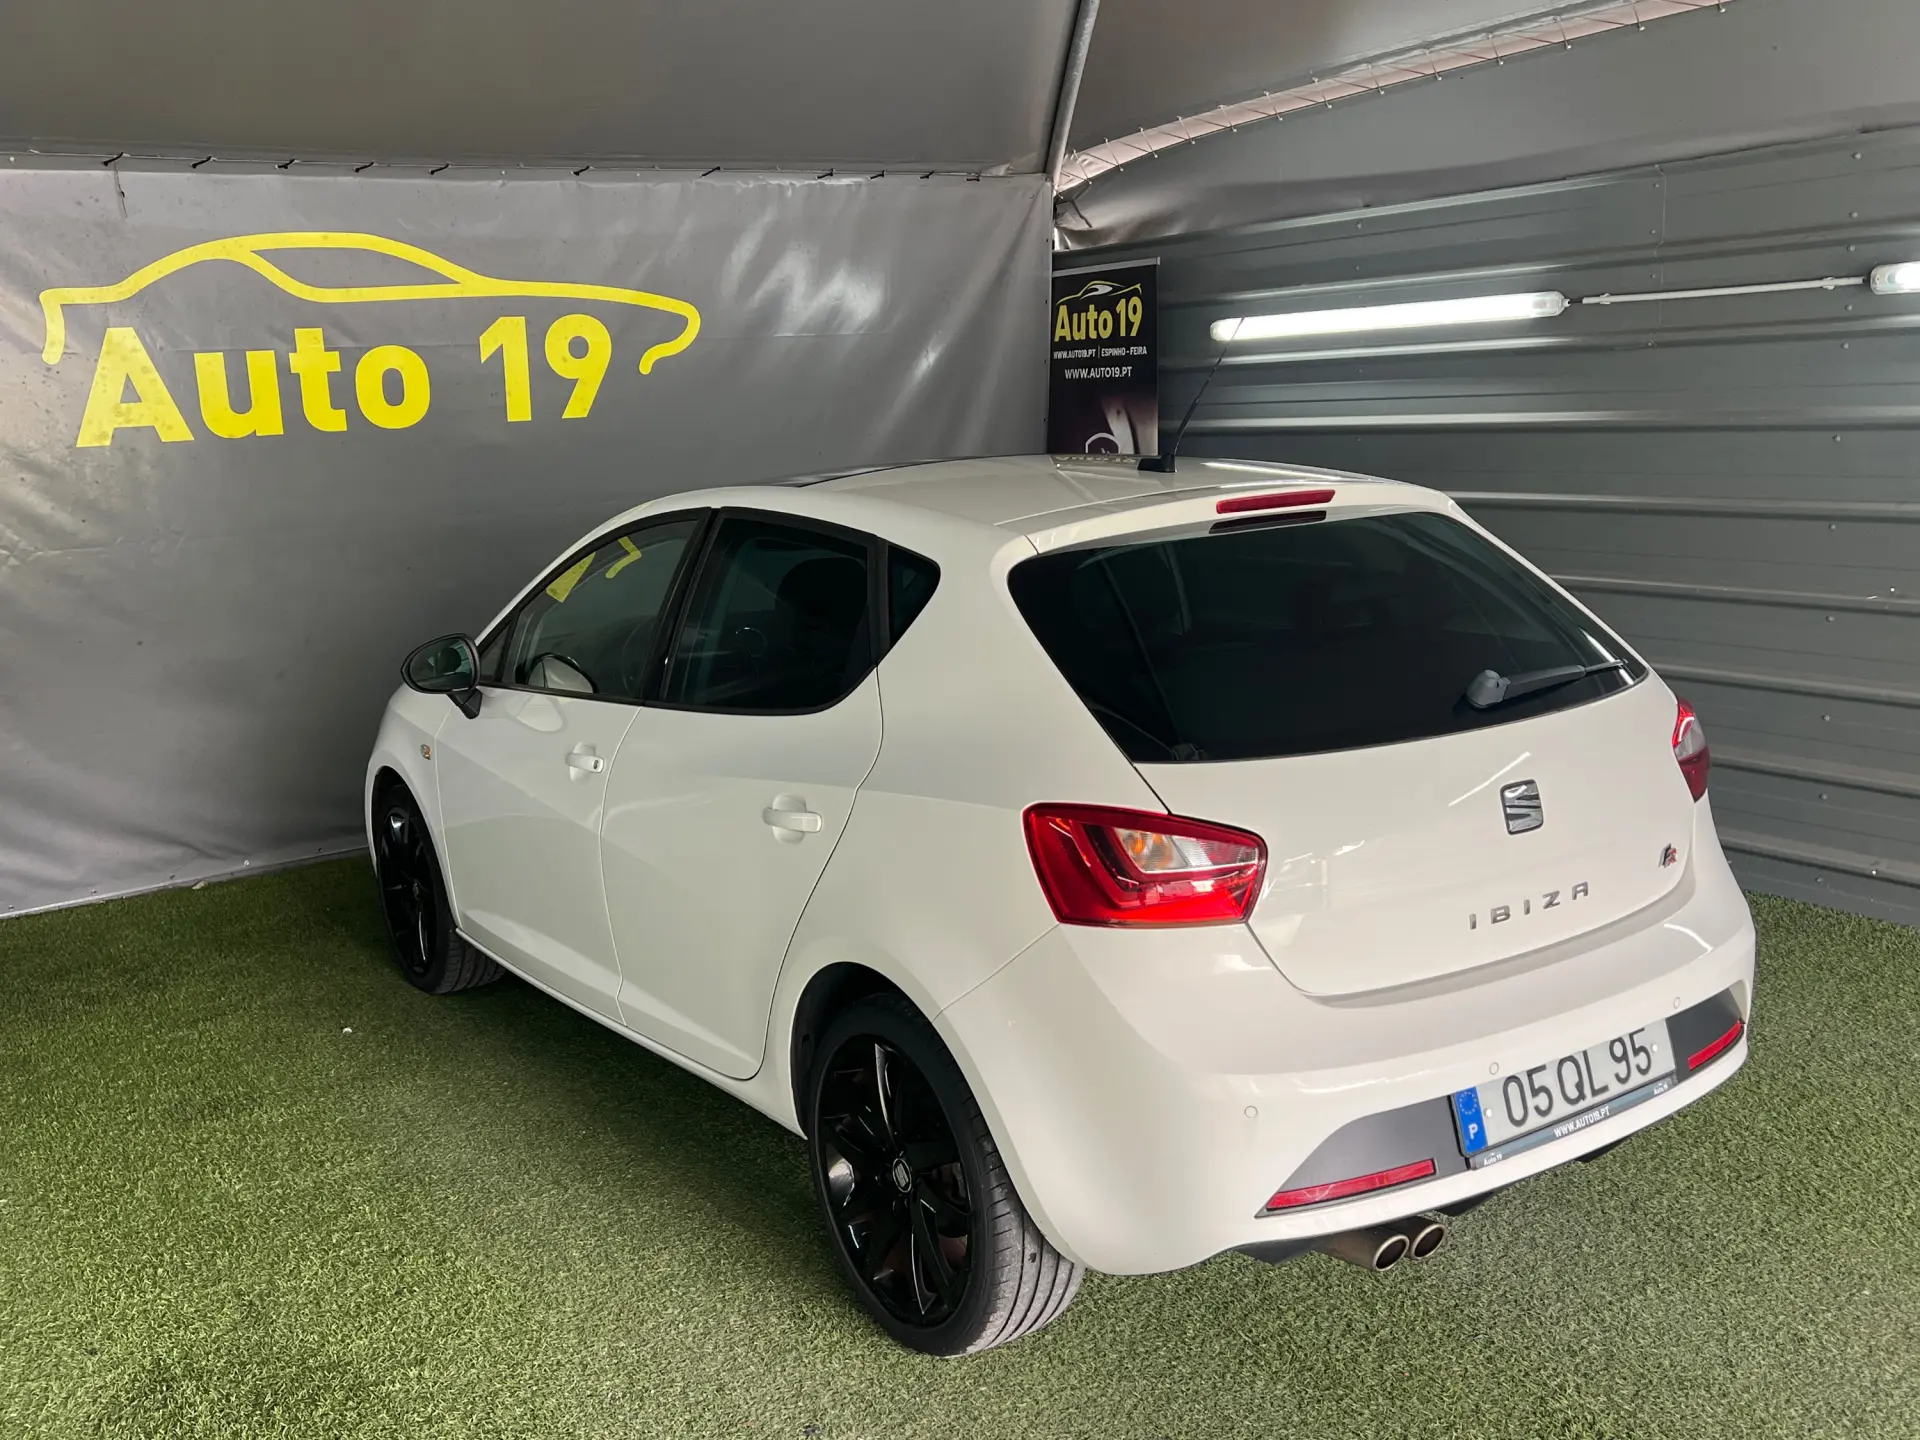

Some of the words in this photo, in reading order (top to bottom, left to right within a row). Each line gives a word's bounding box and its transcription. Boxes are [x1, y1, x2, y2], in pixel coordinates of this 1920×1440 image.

[1054, 304, 1113, 342] Auto
[1116, 296, 1143, 337] 19
[1053, 349, 1096, 359] WWW.AUTO19.PT
[1101, 347, 1126, 356] ESPINHO
[1130, 346, 1148, 355] FEIRA
[77, 327, 430, 447] Auto
[479, 314, 612, 422] 19
[1065, 366, 1132, 379] WWW.AUTO19.PT
[1469, 881, 1589, 930] IBIZA
[1502, 1064, 1553, 1127] 05
[1557, 1050, 1609, 1105] QL
[1609, 1027, 1652, 1084] 95
[1468, 1123, 1479, 1140] P
[1553, 1105, 1610, 1138] WWW.AUTO19.PT
